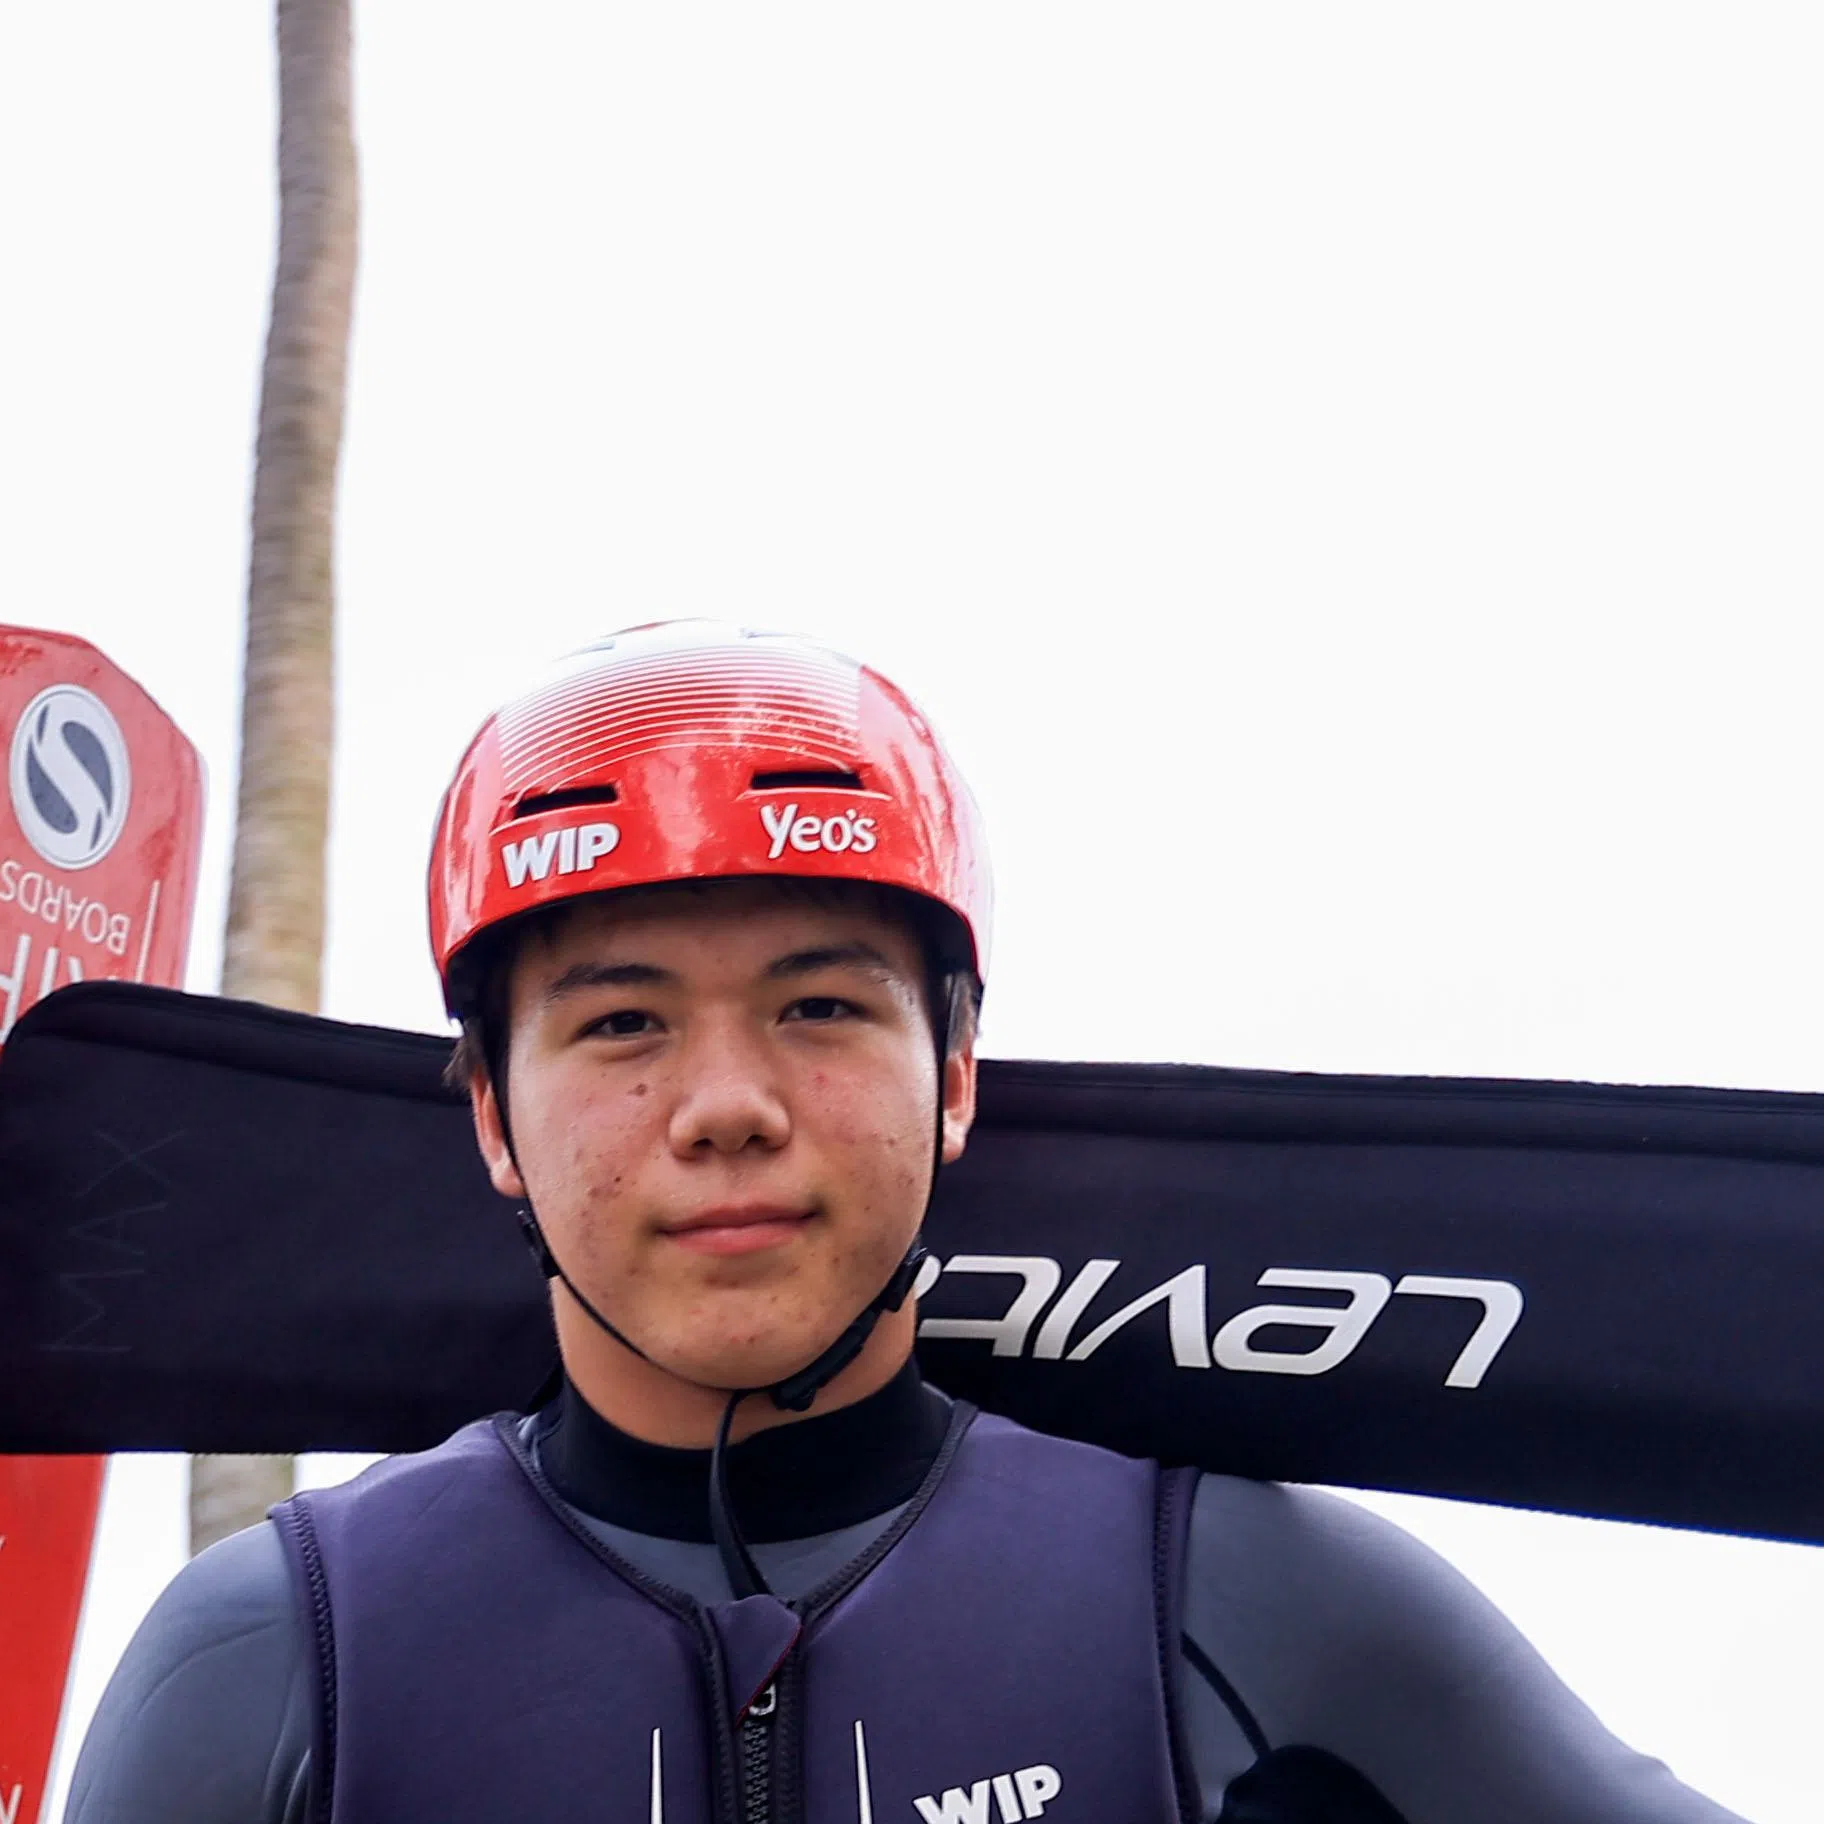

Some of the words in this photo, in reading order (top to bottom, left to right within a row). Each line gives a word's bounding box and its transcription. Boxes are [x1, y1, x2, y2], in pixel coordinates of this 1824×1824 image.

[501, 823, 620, 888] WIP
[761, 803, 877, 859] Yeo's
[40, 1129, 186, 1355] MAX
